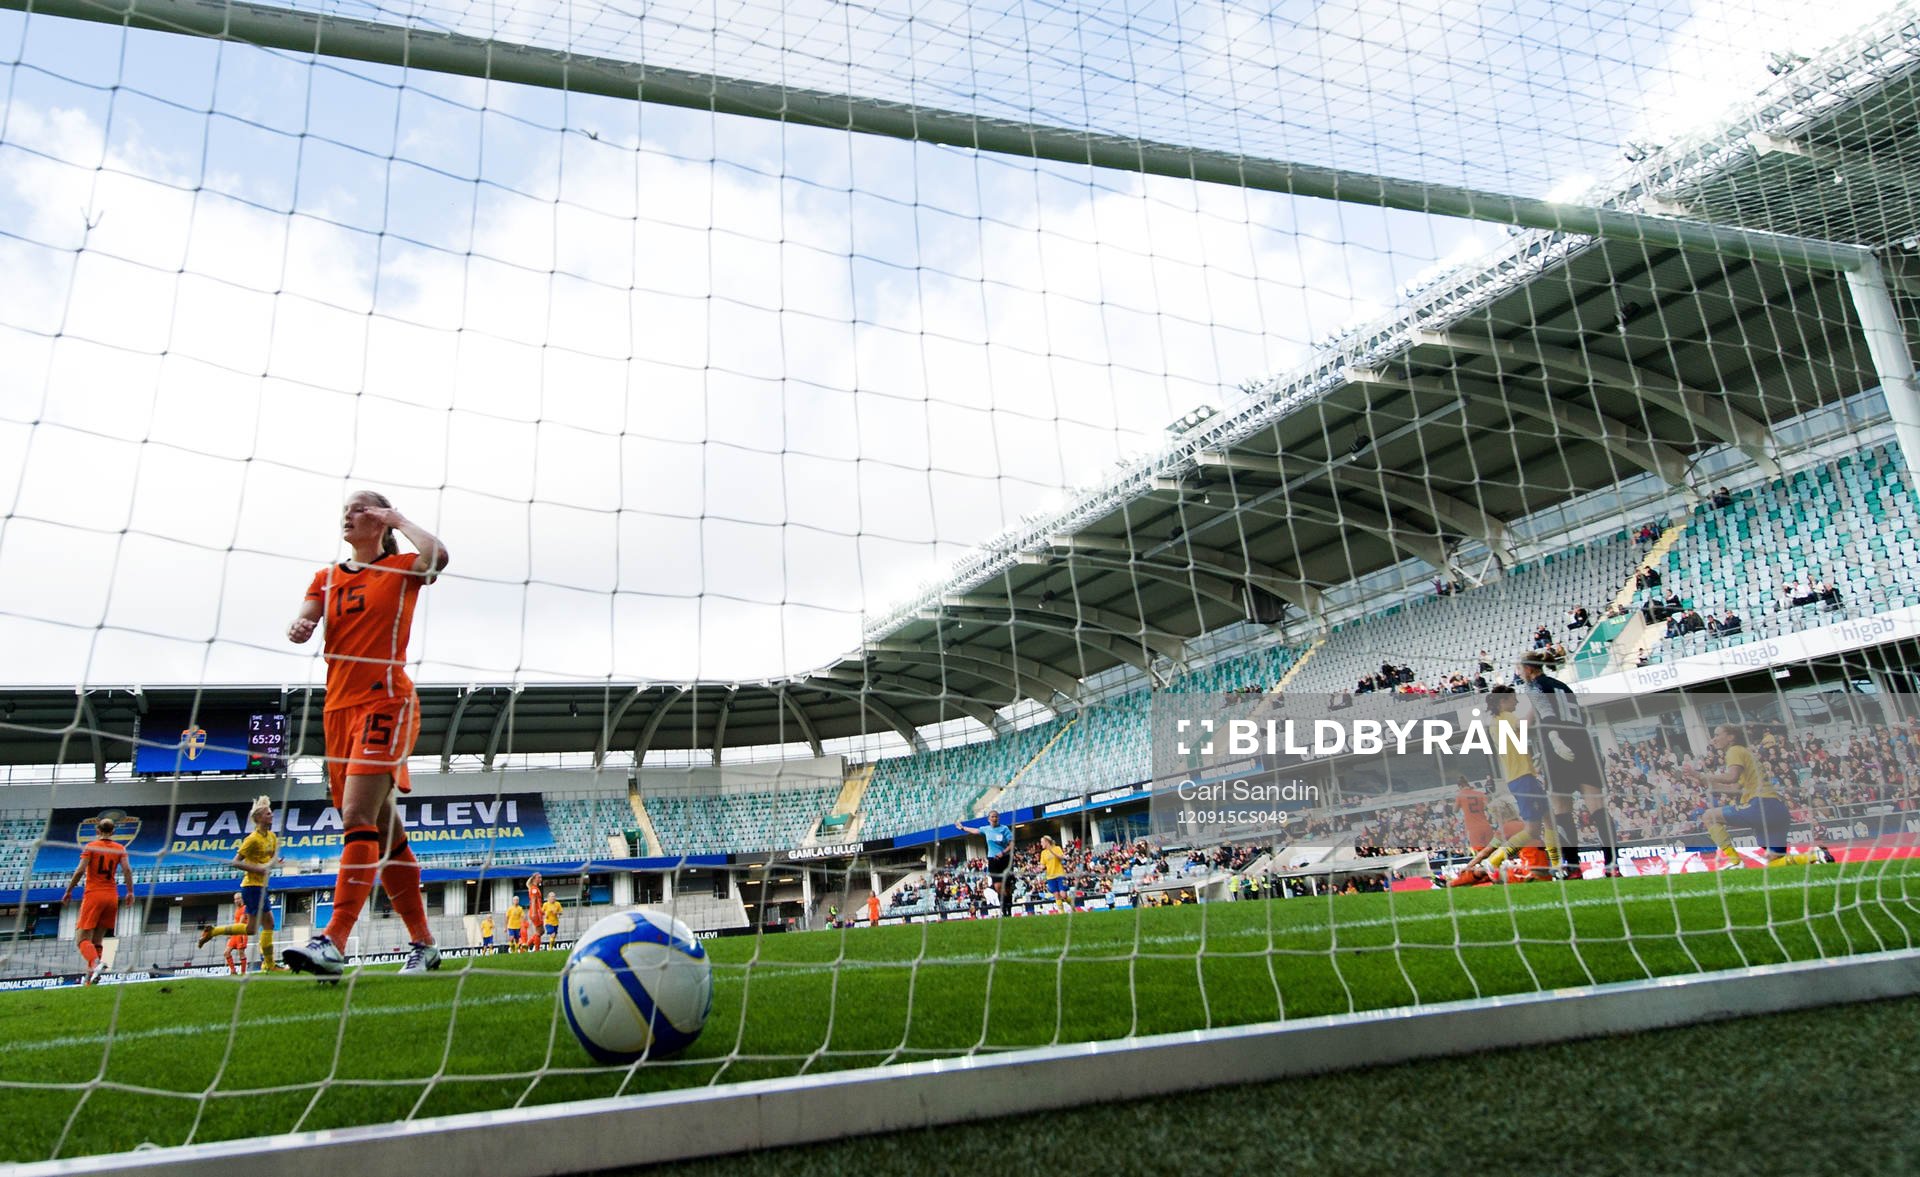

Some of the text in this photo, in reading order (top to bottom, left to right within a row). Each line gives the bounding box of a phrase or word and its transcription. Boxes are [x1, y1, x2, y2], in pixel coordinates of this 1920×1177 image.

[336, 586, 367, 616] 15
[1841, 616, 1895, 641] higab
[1732, 642, 1778, 665] higab
[1636, 663, 1678, 686] higab
[253, 721, 260, 730] 2
[276, 721, 280, 730] 1
[361, 713, 393, 746] 15
[252, 735, 281, 744] 65:29
[396, 800, 518, 827] LLEVI
[788, 843, 864, 860] GAMLA ULLEVI
[98, 855, 115, 880] 4
